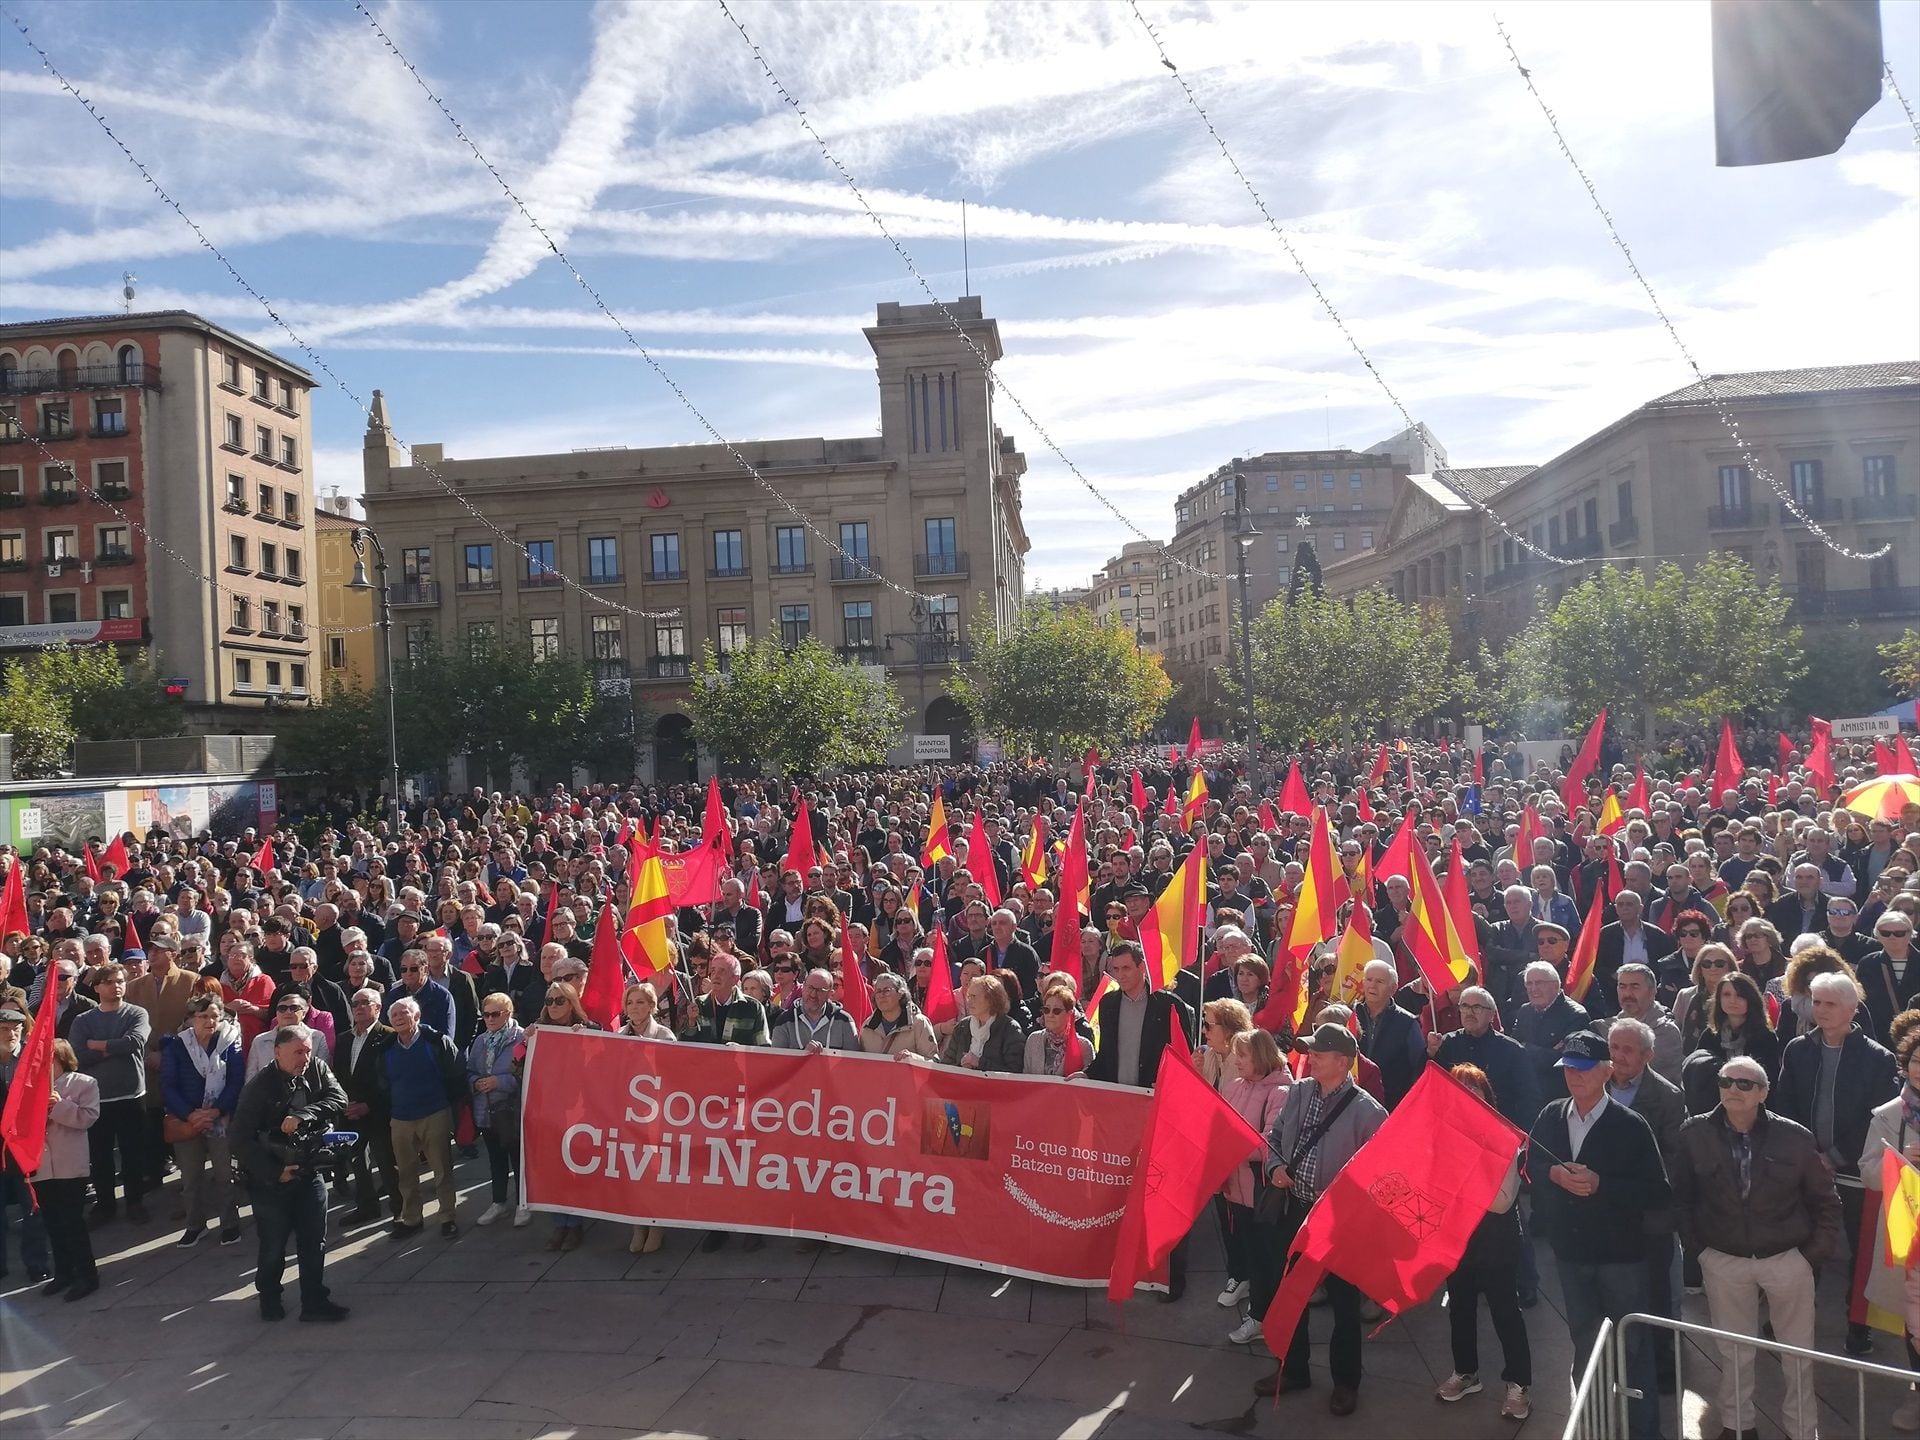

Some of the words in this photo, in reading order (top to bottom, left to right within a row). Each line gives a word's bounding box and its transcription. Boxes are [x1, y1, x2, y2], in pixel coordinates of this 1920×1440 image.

[13, 630, 51, 639] ACADEMIA
[51, 629, 61, 637] DE
[1840, 721, 1877, 732] AMNISTIA
[1879, 721, 1889, 730] NO
[625, 1074, 897, 1147] Sociedad
[1015, 1135, 1035, 1151] Lo
[1039, 1141, 1067, 1157] que
[1071, 1147, 1098, 1161] nos
[1102, 1152, 1131, 1167] une
[561, 1123, 691, 1185] Civil
[702, 1136, 957, 1216] Navarra
[1010, 1153, 1063, 1176] Batzen
[1067, 1166, 1133, 1186] gaituena
